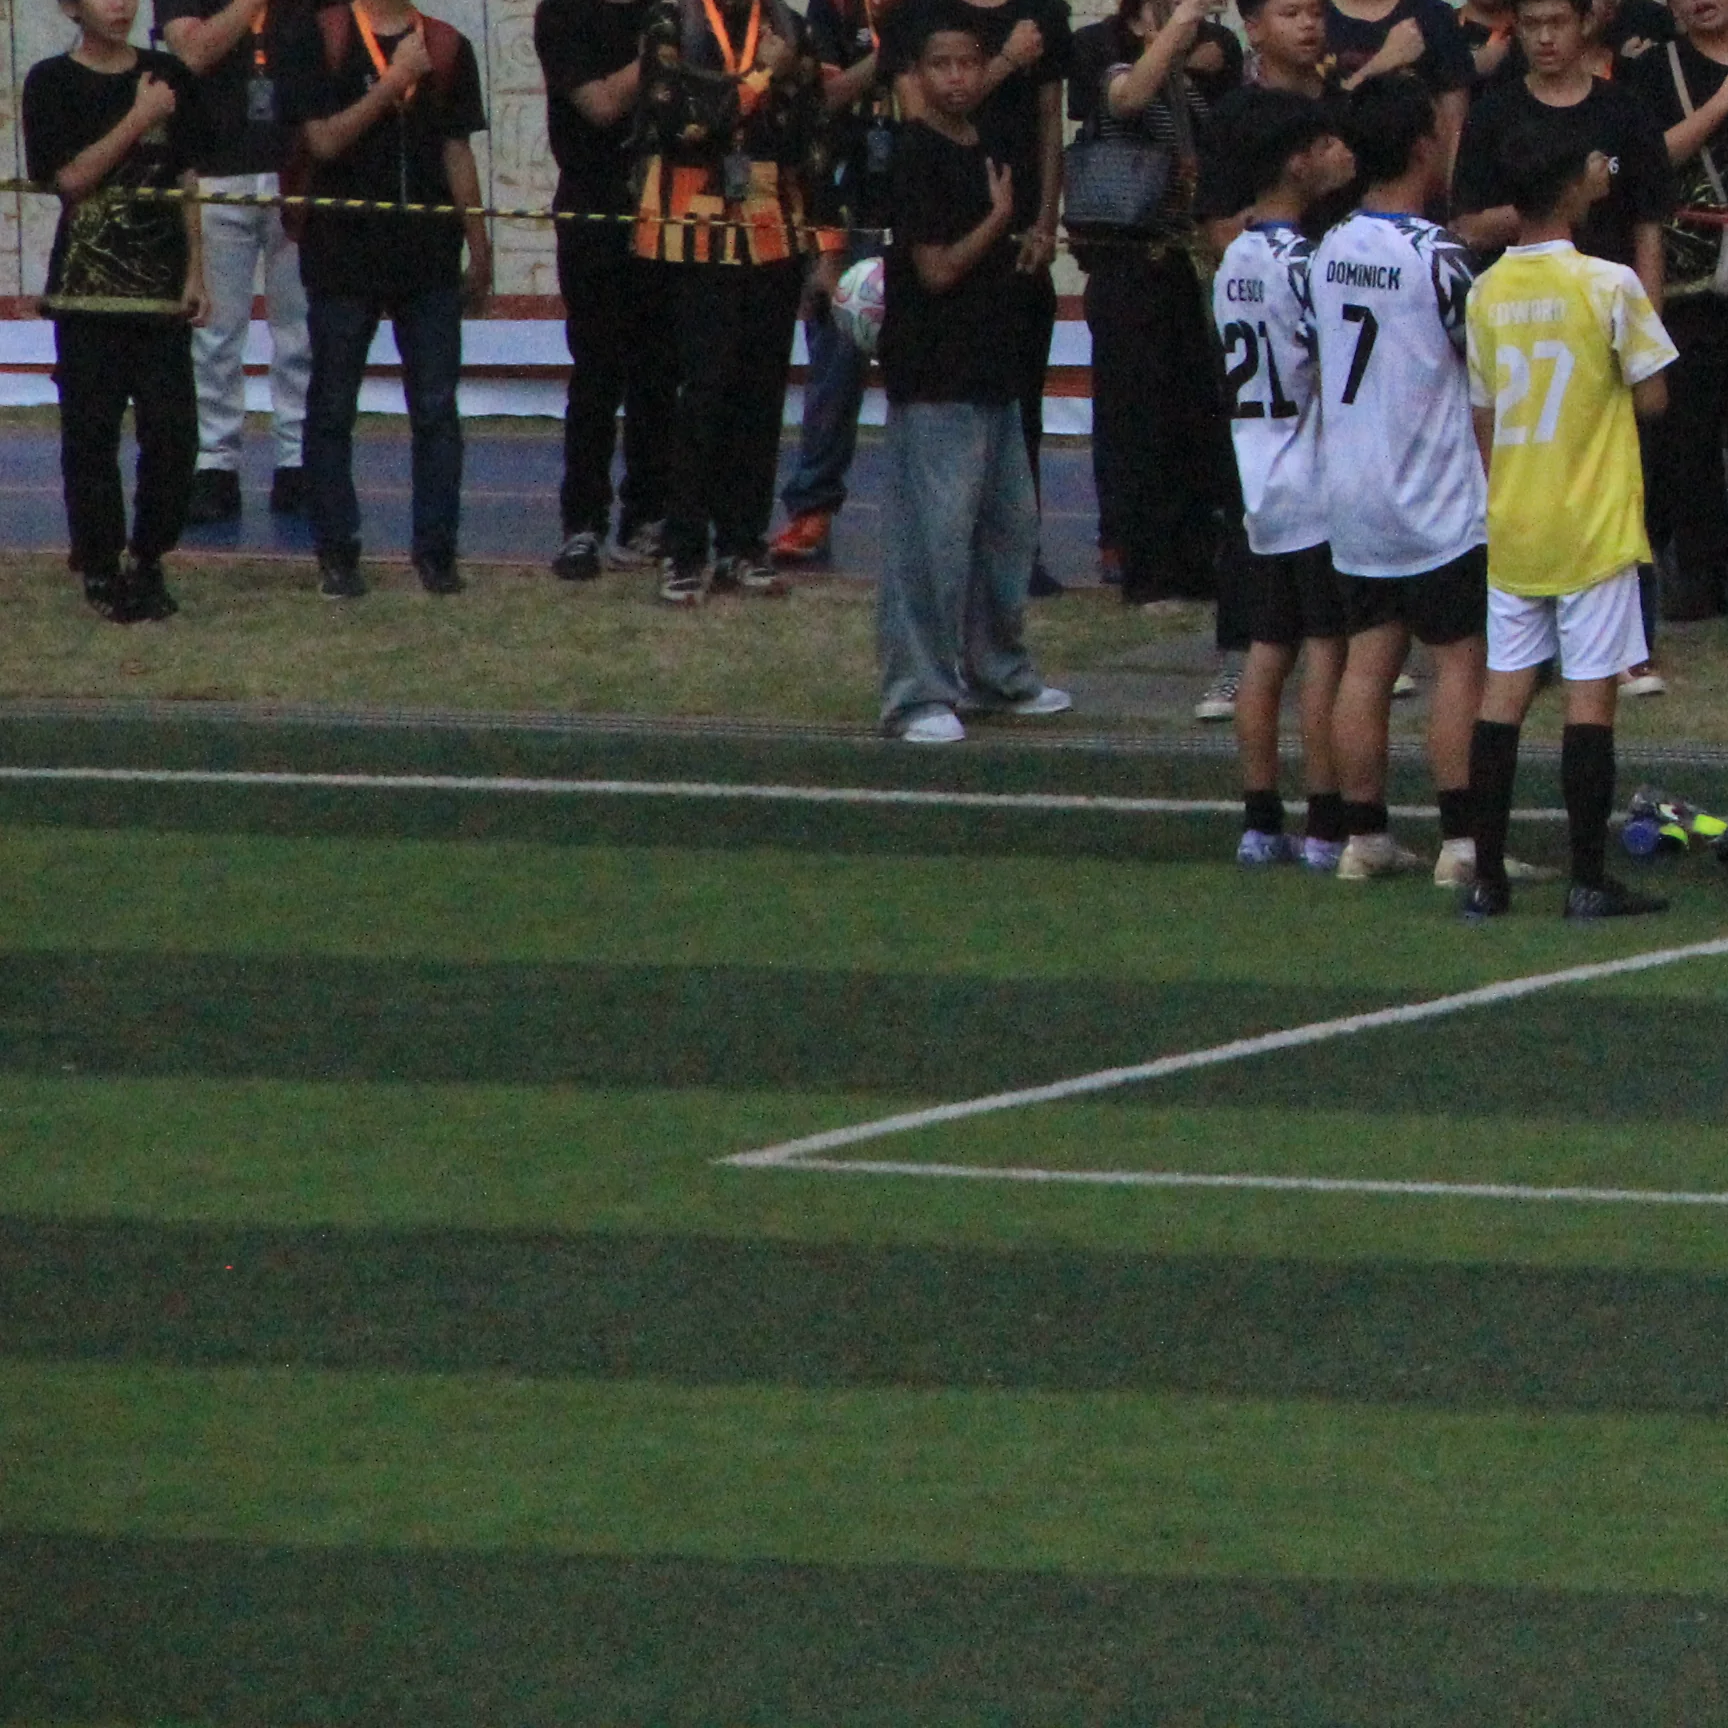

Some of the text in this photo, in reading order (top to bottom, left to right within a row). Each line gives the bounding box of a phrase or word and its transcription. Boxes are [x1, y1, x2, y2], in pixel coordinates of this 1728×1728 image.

[1326, 260, 1400, 290] DOMINICK
[1224, 320, 1299, 419] 21
[1342, 304, 1379, 405] 7
[1494, 340, 1575, 445] 27
